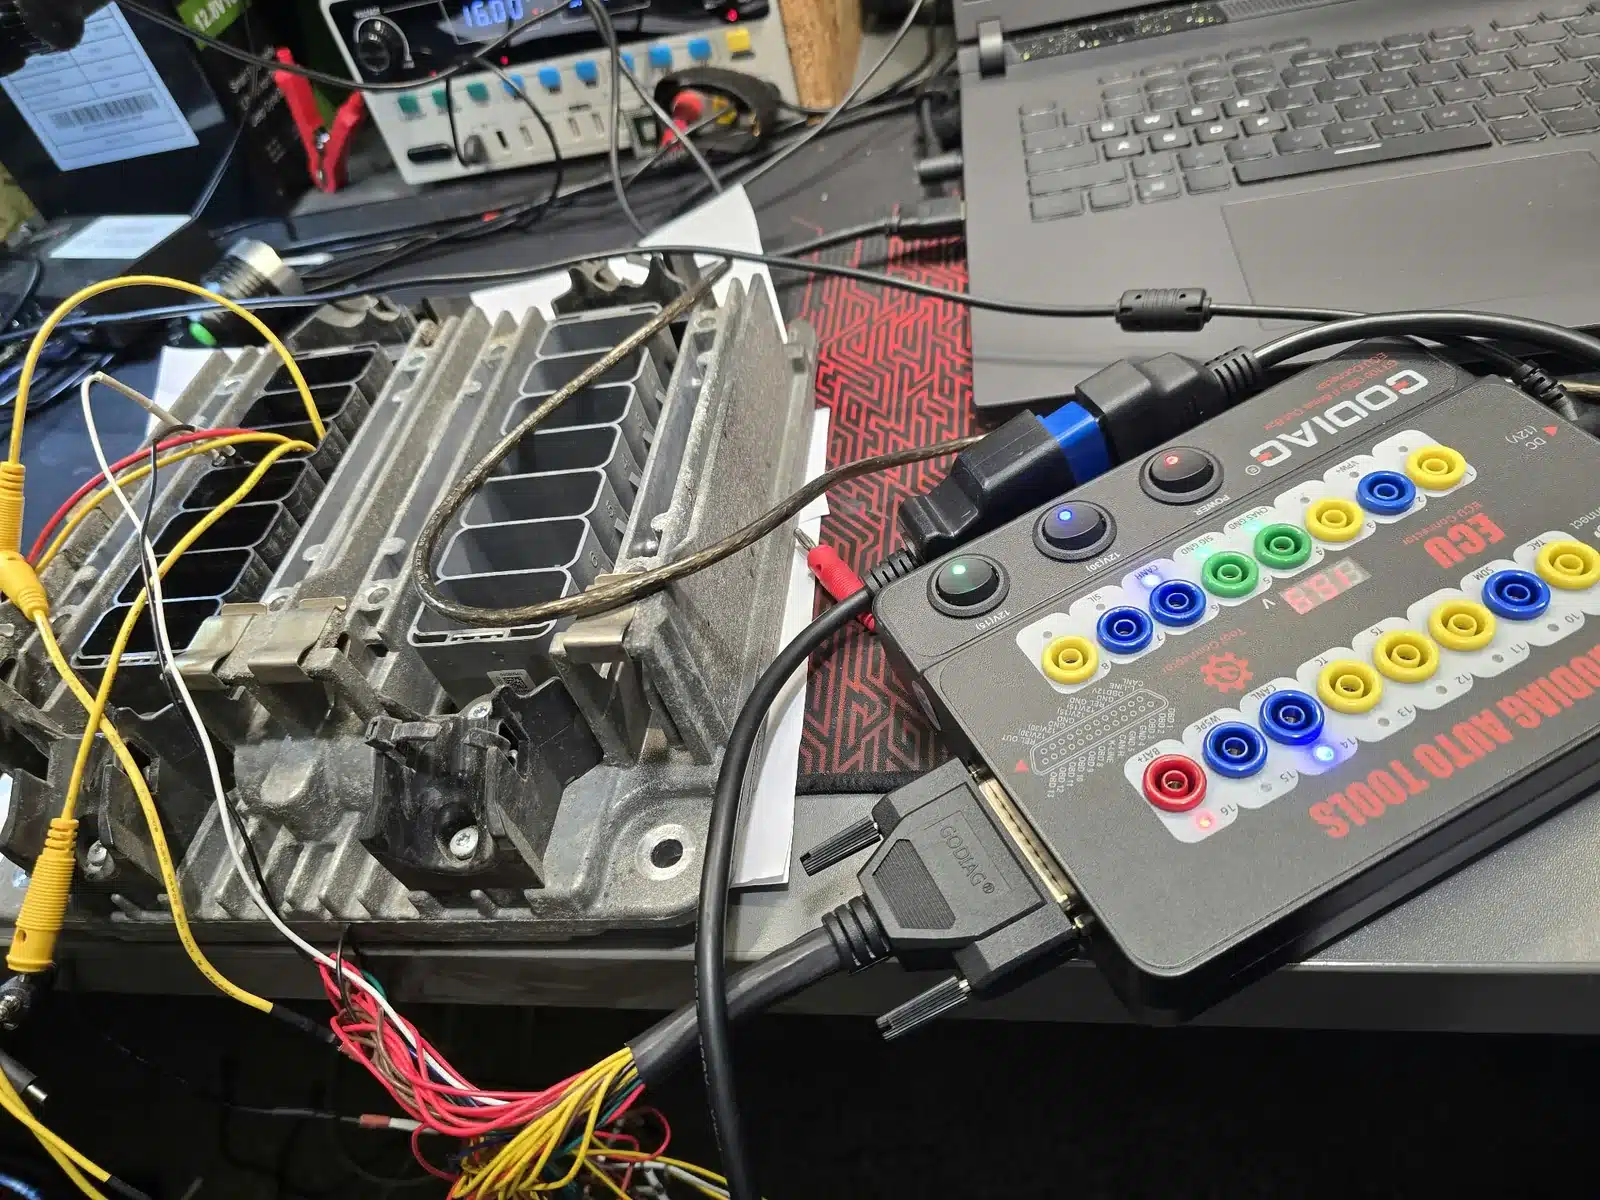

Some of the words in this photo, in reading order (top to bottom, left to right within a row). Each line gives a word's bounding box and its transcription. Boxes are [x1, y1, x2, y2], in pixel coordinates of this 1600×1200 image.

[1504, 422, 1538, 444] (12V)
[1524, 435, 1546, 451] DC
[1193, 492, 1230, 515] POWER
[1455, 500, 1481, 517] ECU
[1244, 505, 1268, 521] CHAS
[1226, 516, 1247, 530] GND
[1197, 533, 1214, 545] SIG
[1421, 510, 1506, 570] ECU
[1525, 537, 1546, 551] TAC
[1179, 541, 1200, 555] GND
[1084, 549, 1120, 573] 12V(30)
[1133, 563, 1159, 580] CANH
[1474, 566, 1495, 581] SDM
[1262, 598, 1275, 610] V
[974, 607, 1011, 631] 12V(15)
[1564, 612, 1580, 624] 10
[1368, 626, 1383, 636] TS
[1509, 643, 1526, 654] 11
[1313, 655, 1328, 666] TC
[1455, 671, 1471, 685] 12
[1096, 694, 1113, 702] GND
[1249, 683, 1276, 700] CANL
[1069, 696, 1086, 704] GND
[1397, 705, 1413, 717] 13
[1047, 720, 1065, 728] GND
[1056, 715, 1074, 723] GND
[1340, 738, 1356, 750] 14
[1412, 709, 1513, 778] AUTO
[1134, 747, 1161, 763] BAT+
[1280, 770, 1296, 783] 15
[1309, 759, 1430, 839] TOOLS
[1220, 804, 1237, 816] 16
